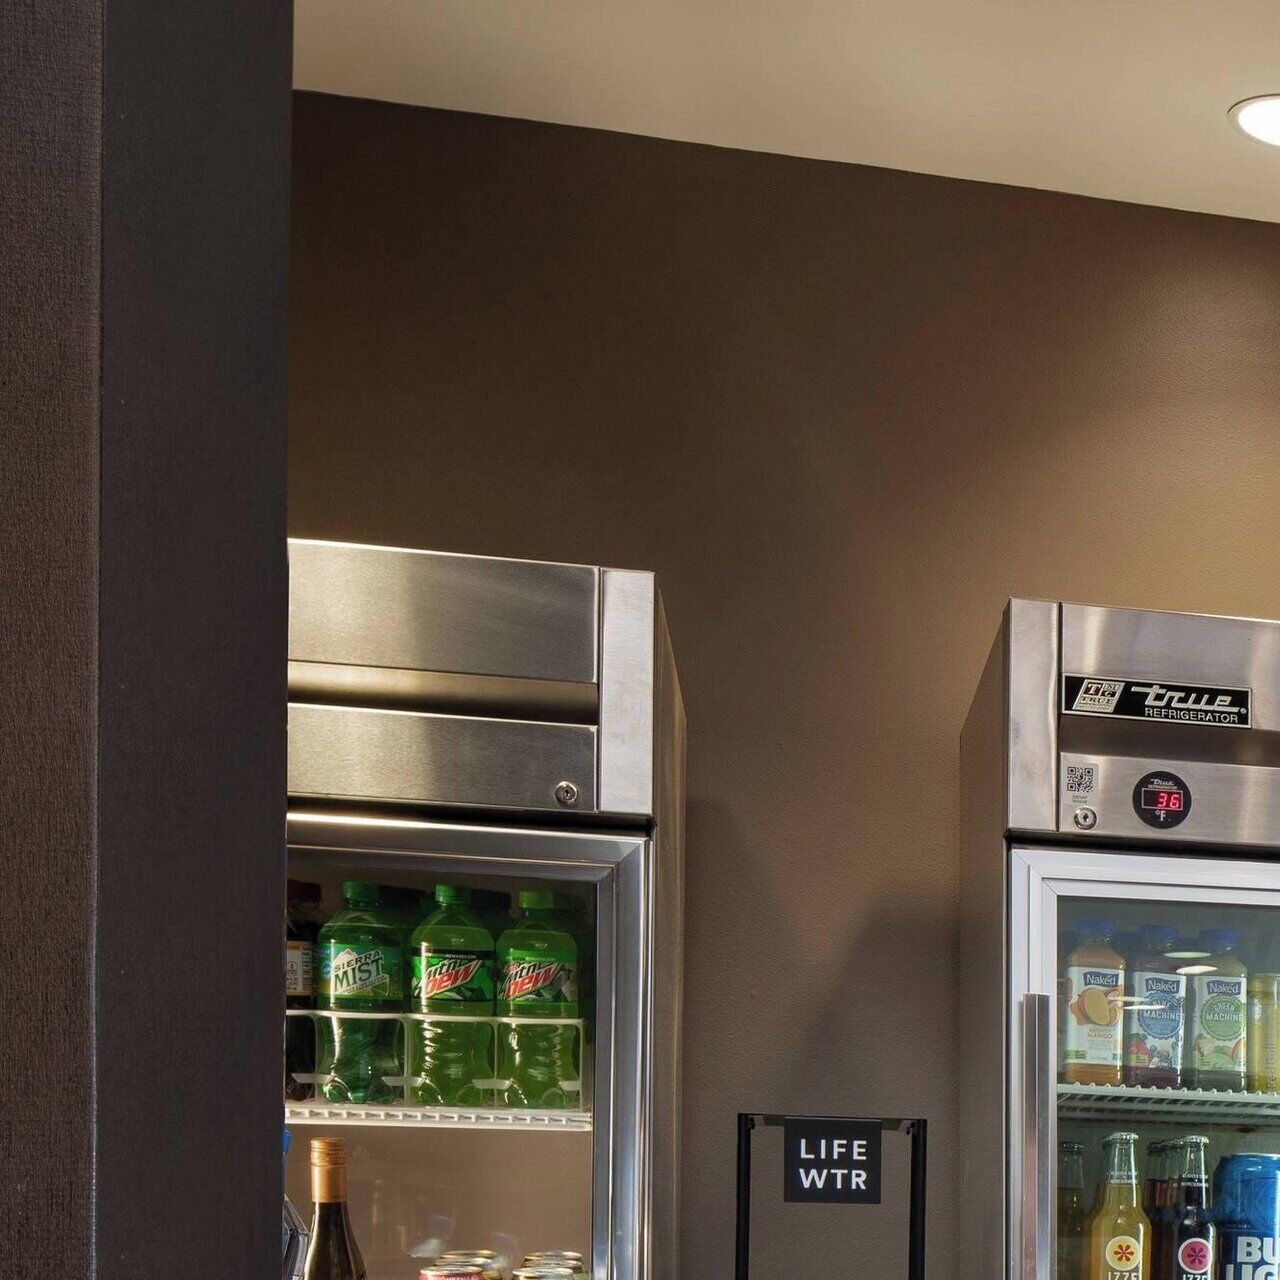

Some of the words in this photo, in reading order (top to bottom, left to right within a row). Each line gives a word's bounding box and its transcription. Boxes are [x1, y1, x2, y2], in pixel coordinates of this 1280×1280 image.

[1144, 707, 1239, 725] REFRIGERATOR
[1157, 792, 1180, 808] 36
[334, 951, 380, 973] SIERRA
[335, 957, 383, 993] MIST
[1086, 973, 1117, 987] Naked
[1148, 978, 1177, 992] Naked
[1210, 980, 1239, 994] Naked
[1213, 1002, 1236, 1012] GREEN
[1143, 1010, 1181, 1021] MACHINE
[1206, 1012, 1243, 1022] MACHINE
[800, 1138, 867, 1160] LIFE
[799, 1168, 867, 1190] WTR
